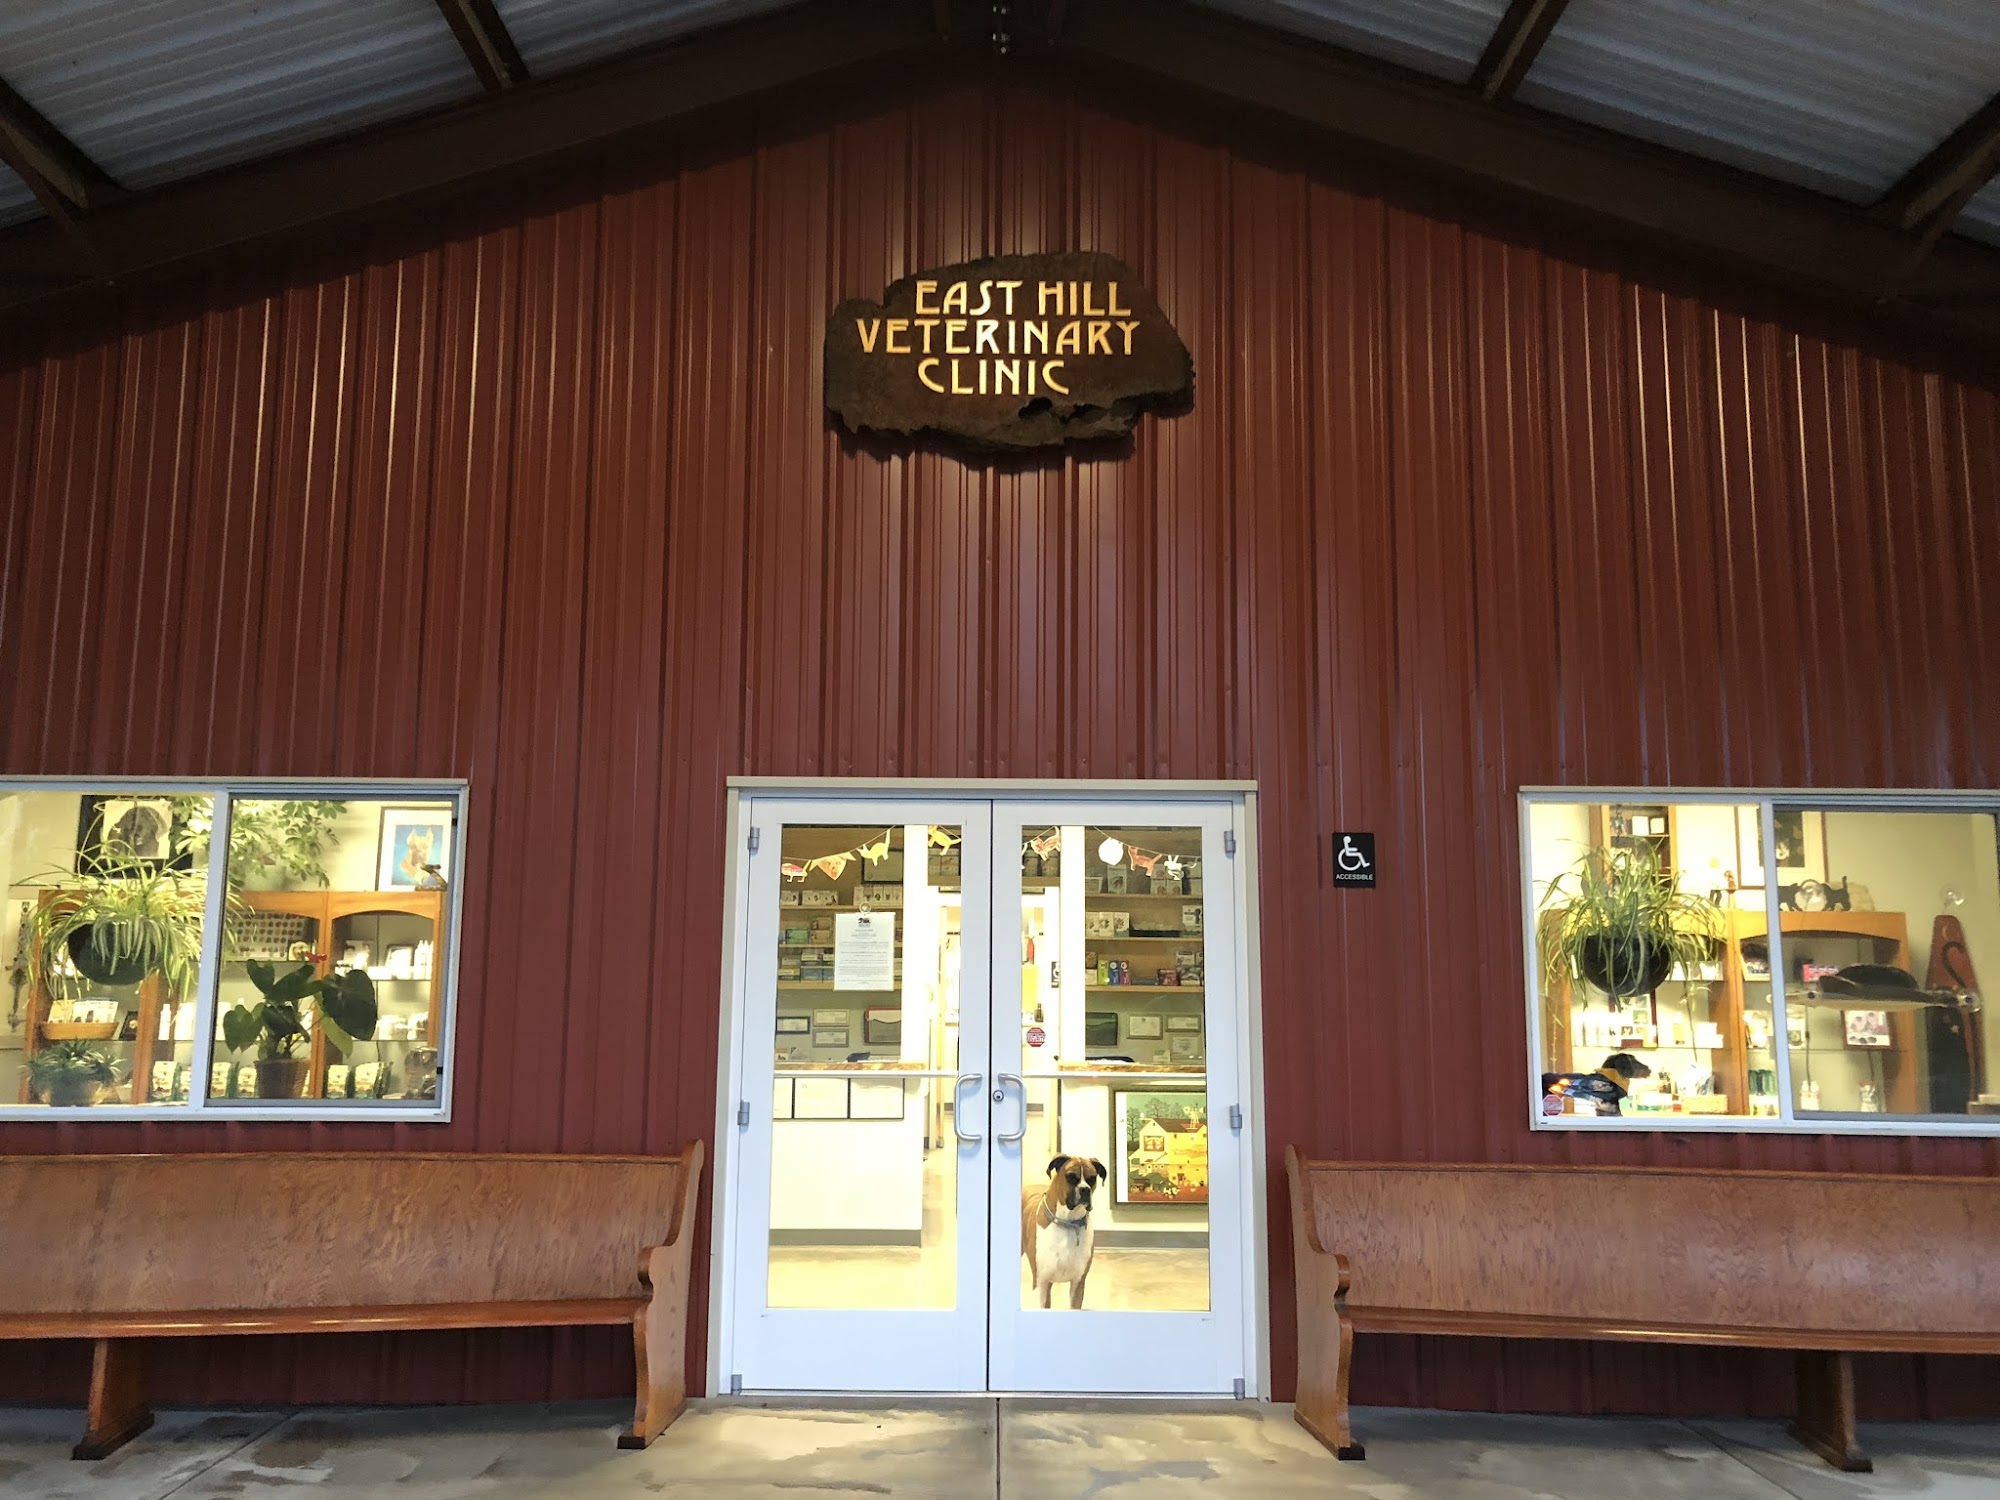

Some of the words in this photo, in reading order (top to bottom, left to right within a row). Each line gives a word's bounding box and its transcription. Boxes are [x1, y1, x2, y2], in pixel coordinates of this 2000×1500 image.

[915, 279, 1023, 316] EAST
[1038, 280, 1132, 317] HILL
[856, 318, 1141, 356] VETERINARY
[917, 358, 1070, 395] CLINIC
